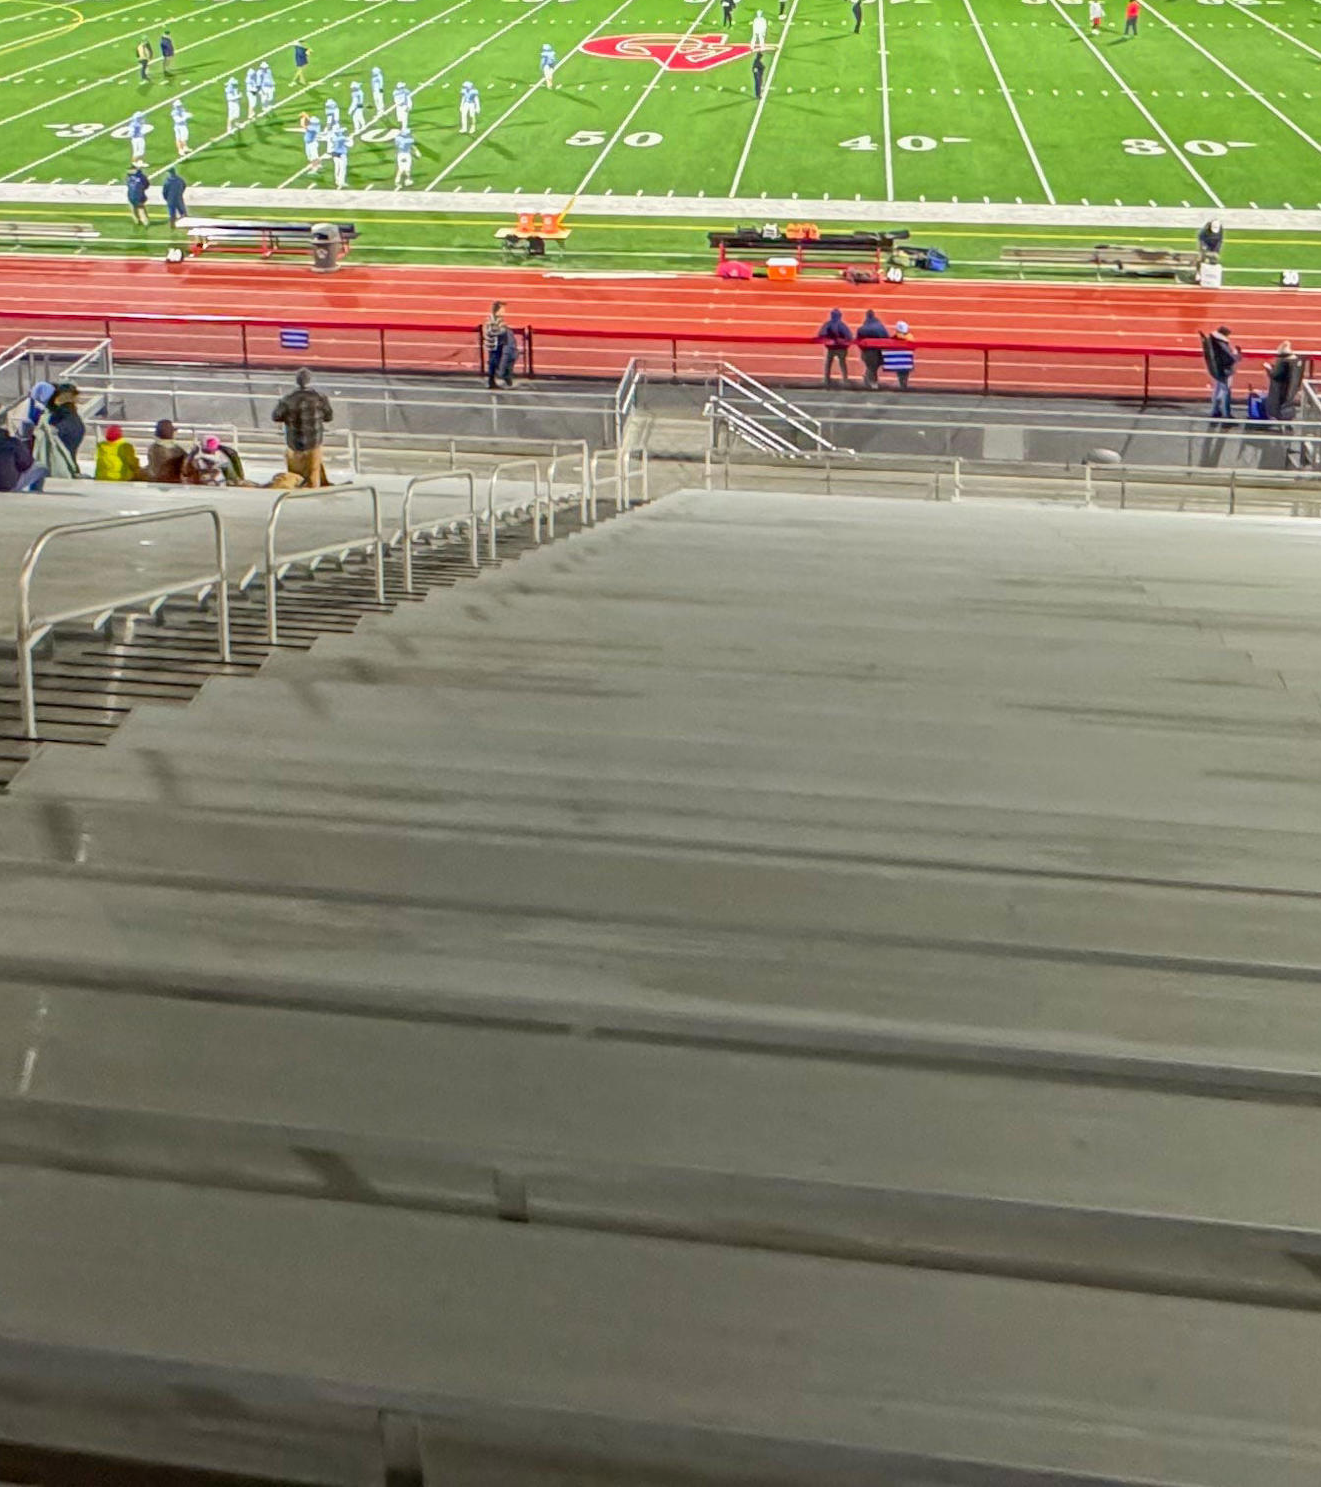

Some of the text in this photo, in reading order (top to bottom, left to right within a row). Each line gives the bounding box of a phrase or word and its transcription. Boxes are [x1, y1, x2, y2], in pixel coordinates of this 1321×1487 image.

[565, 129, 664, 147] 50
[838, 134, 938, 152] 40
[1121, 137, 1230, 157] 30
[886, 267, 903, 282] 40
[1282, 270, 1300, 286] 30
